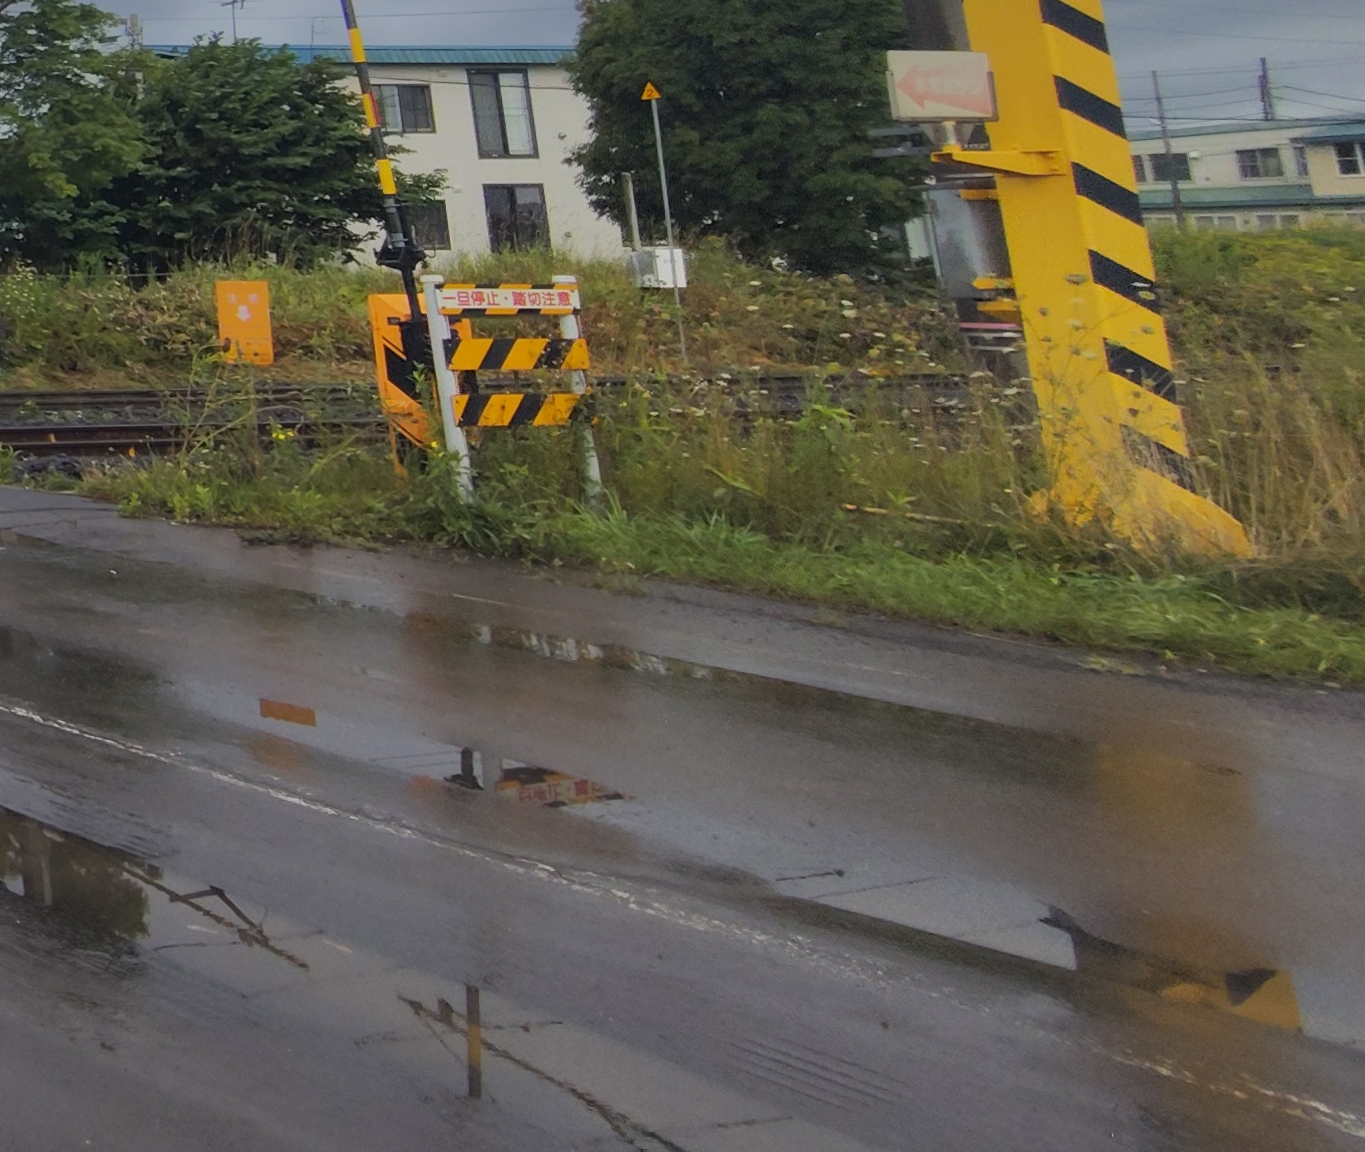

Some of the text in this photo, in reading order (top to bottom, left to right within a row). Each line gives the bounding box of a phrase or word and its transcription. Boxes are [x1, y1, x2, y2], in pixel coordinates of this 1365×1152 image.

[441, 290, 572, 307] 一旦停止・踏切注意
